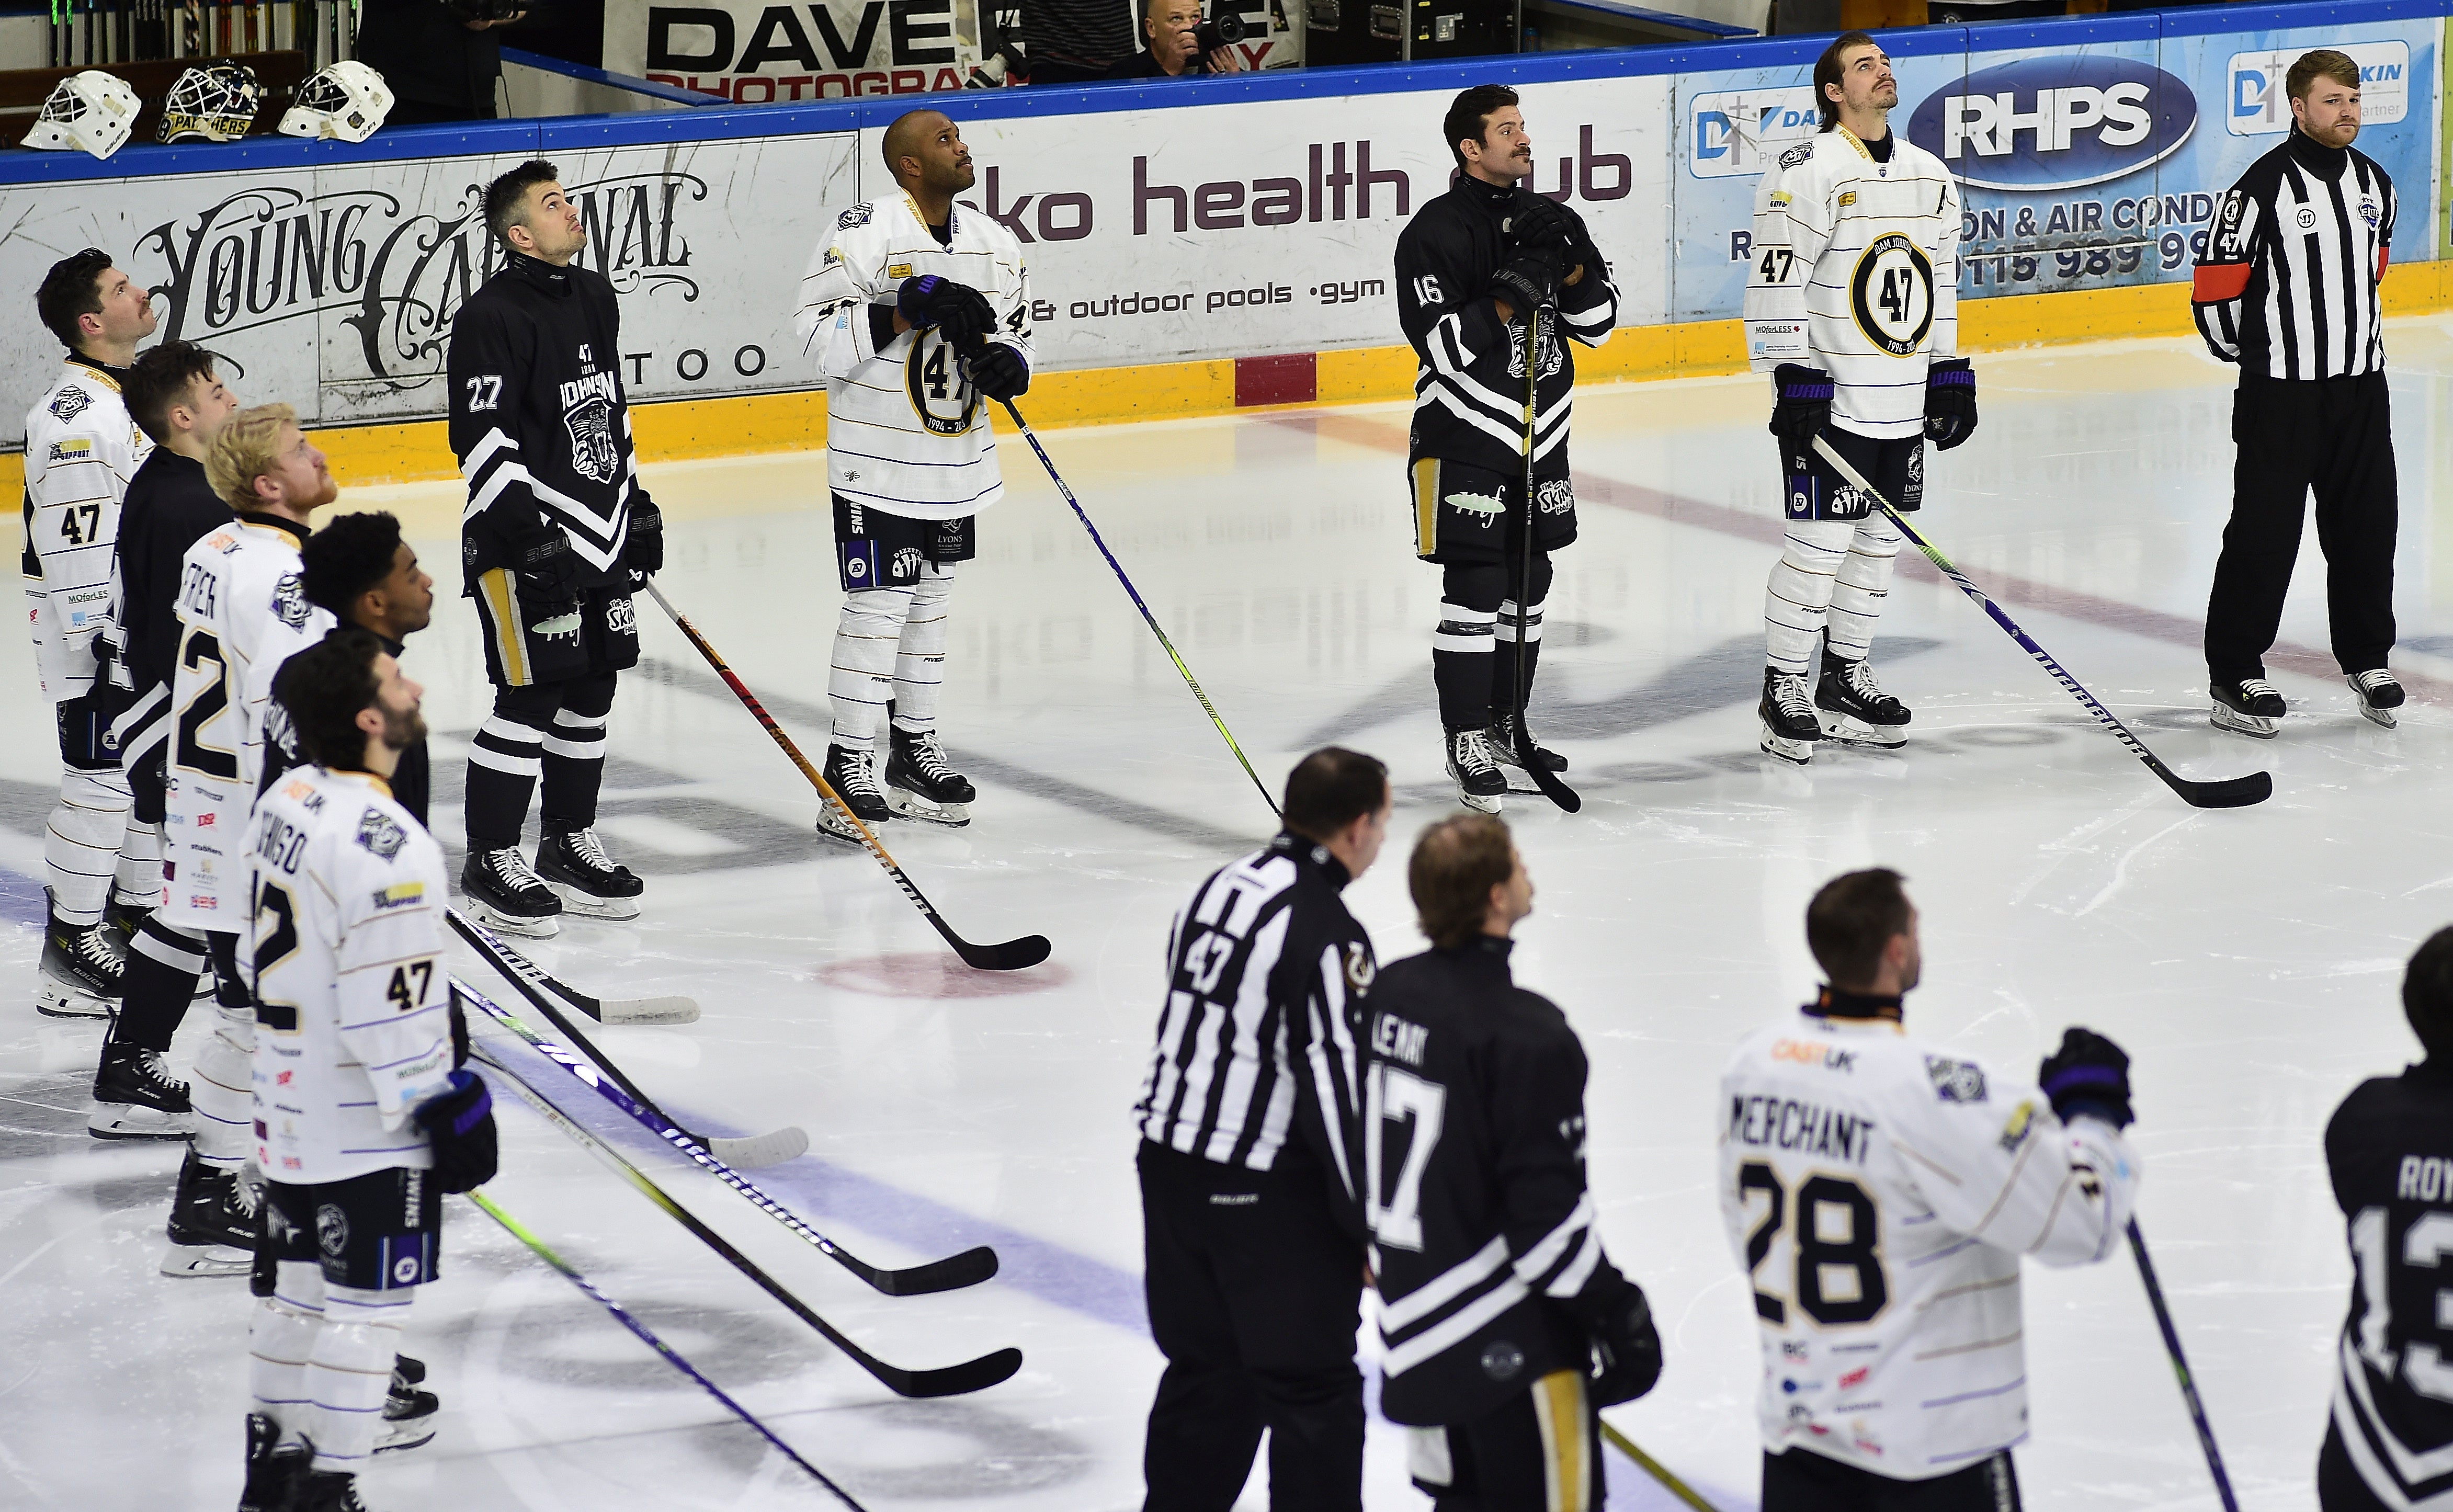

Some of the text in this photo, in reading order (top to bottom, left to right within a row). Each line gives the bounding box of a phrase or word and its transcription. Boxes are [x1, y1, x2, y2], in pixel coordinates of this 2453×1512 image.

[175, 115, 246, 134] PANHERS
[1944, 82, 2152, 160] RHPS
[1133, 140, 1410, 236] health
[2015, 206, 2038, 238] &
[2047, 200, 2102, 236] AIR
[2057, 234, 2142, 278] 989
[2220, 232, 2241, 253] 47
[133, 187, 400, 348] YOUNG
[1760, 249, 1793, 283] 47
[1031, 299, 1057, 322] &
[1070, 291, 1195, 320] outdoor
[1206, 281, 1292, 314] pools
[1413, 274, 1445, 308] 16
[1878, 267, 1913, 323] 47
[578, 344, 592, 362] 47
[1887, 340, 1902, 354] 1994
[467, 374, 503, 413] 27
[927, 417, 945, 432] 1994
[61, 503, 101, 547] 47
[938, 535, 962, 543] LYONS
[1840, 696, 1863, 711] BAUER
[72, 967, 105, 988] BAUER
[1184, 929, 1235, 995] 47
[386, 959, 434, 1011] 47
[1730, 1093, 1877, 1167] MERCHANT
[1737, 1158, 1891, 1327] 28
